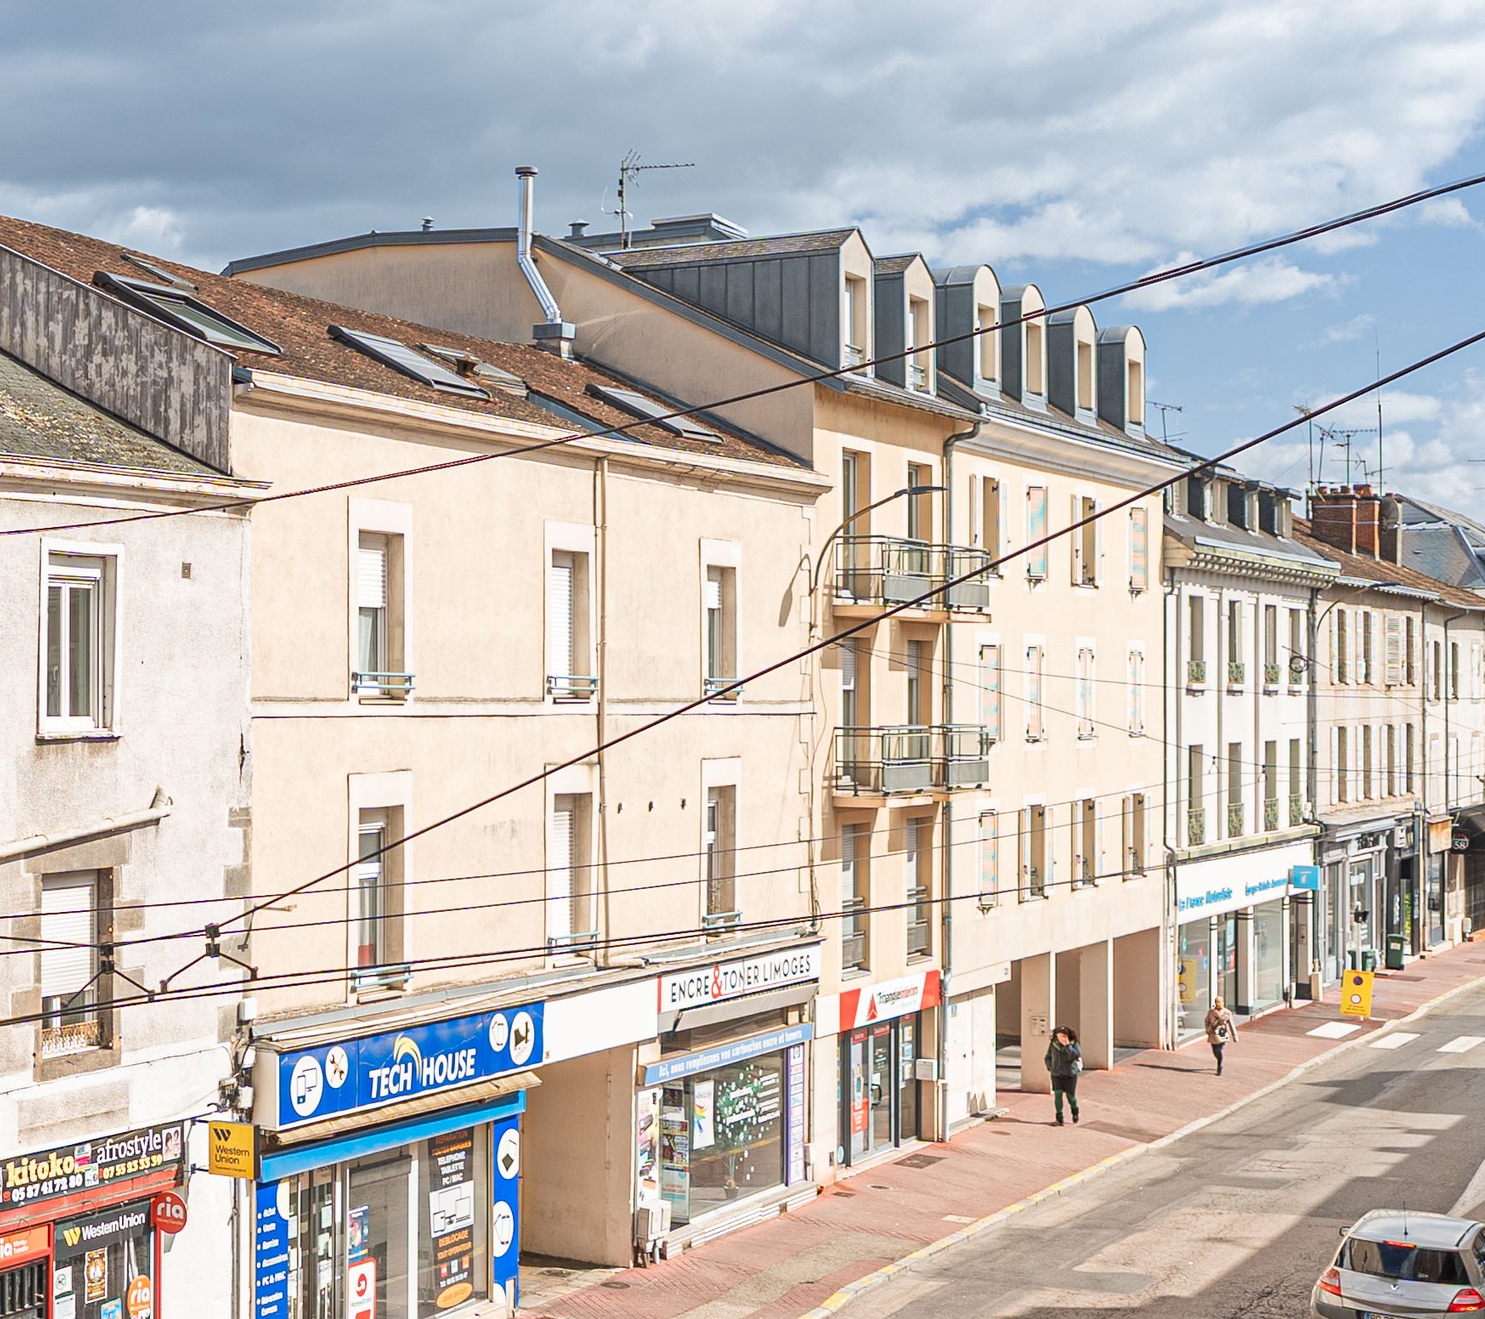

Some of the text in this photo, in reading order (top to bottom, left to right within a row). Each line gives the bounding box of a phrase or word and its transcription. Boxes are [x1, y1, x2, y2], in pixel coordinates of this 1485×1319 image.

[671, 954, 811, 1003] ENCRE & TONER LIMOGES
[720, 1048, 731, 1060] vos
[368, 1048, 477, 1099] TECH HOUSE
[5, 1128, 162, 1188] kitoko afrostyle
[215, 1144, 250, 1157] Western
[215, 1153, 240, 1165] Union
[102, 1165, 115, 1180] 07
[12, 1187, 26, 1203] 05
[40, 1180, 54, 1197] 41
[54, 1177, 68, 1193] 72
[69, 1173, 82, 1189] 80
[157, 1196, 185, 1220] ria
[81, 1221, 120, 1241] Western
[118, 1212, 146, 1230] Union
[130, 1282, 151, 1305] ria
